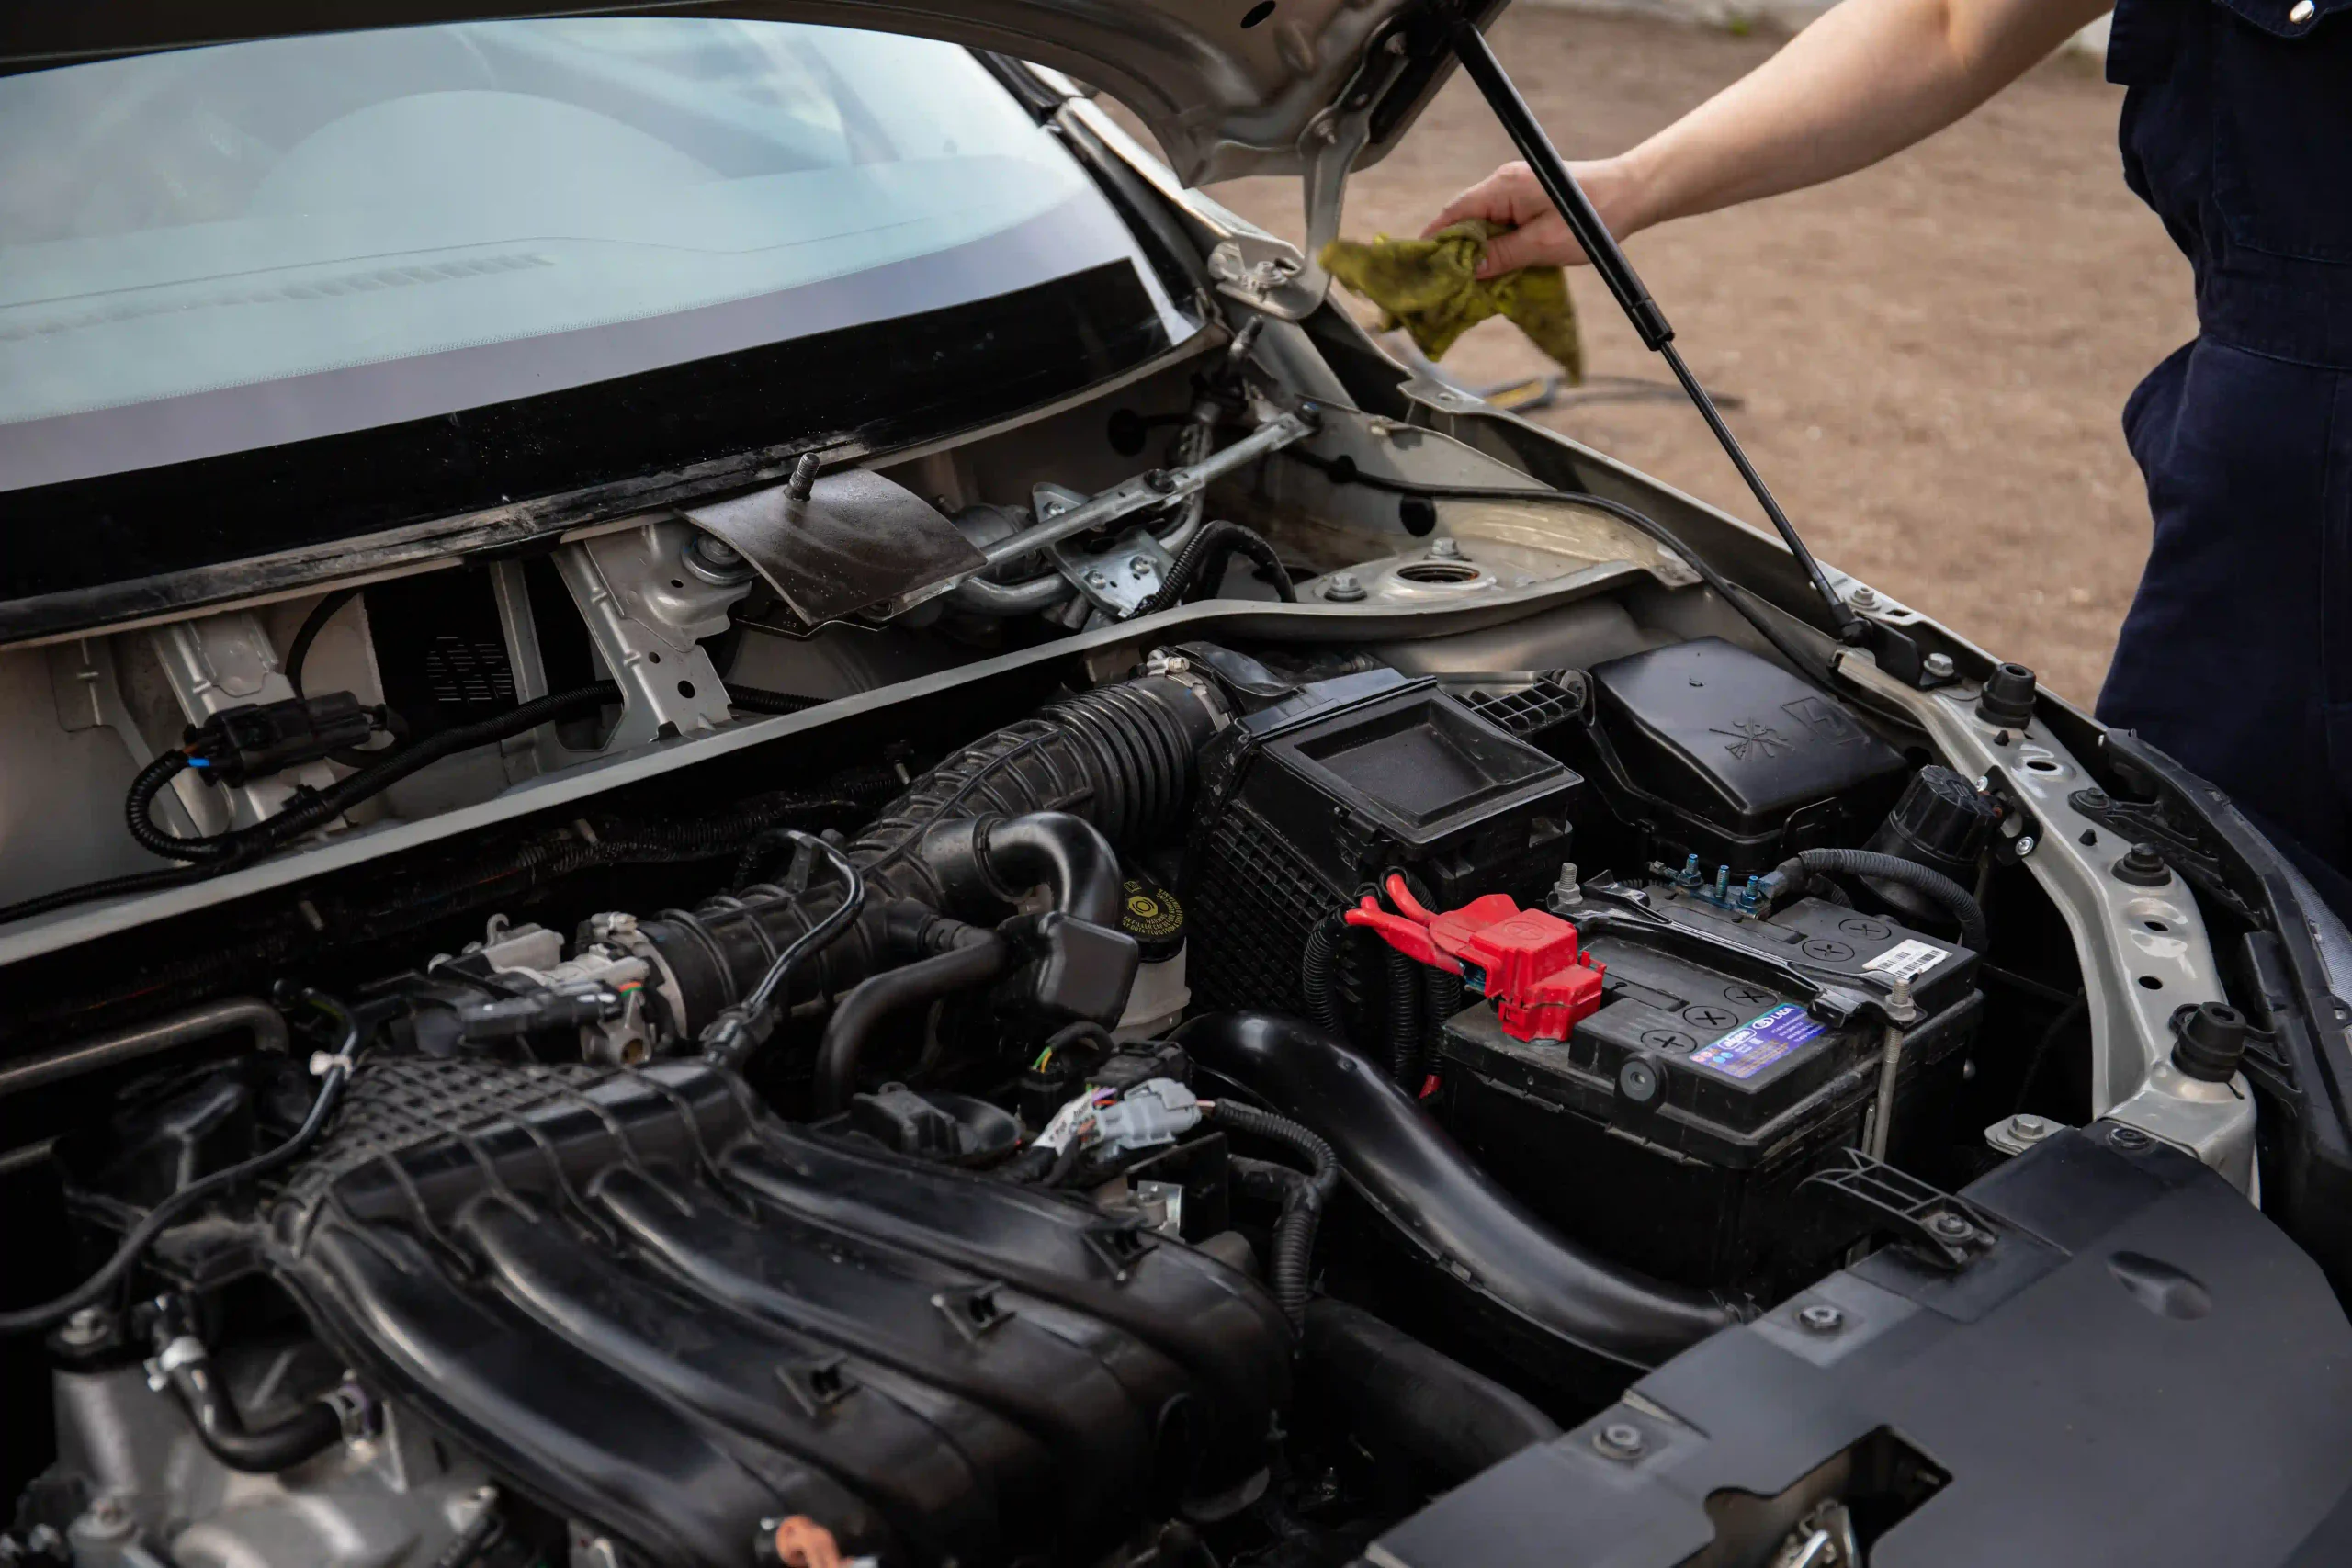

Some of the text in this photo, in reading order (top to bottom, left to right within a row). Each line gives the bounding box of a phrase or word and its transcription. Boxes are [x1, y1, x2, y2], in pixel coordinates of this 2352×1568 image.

[1132, 919, 1152, 929] FILLER
[1145, 913, 1168, 924] WARNING
[1771, 1007, 1795, 1019] LADA
